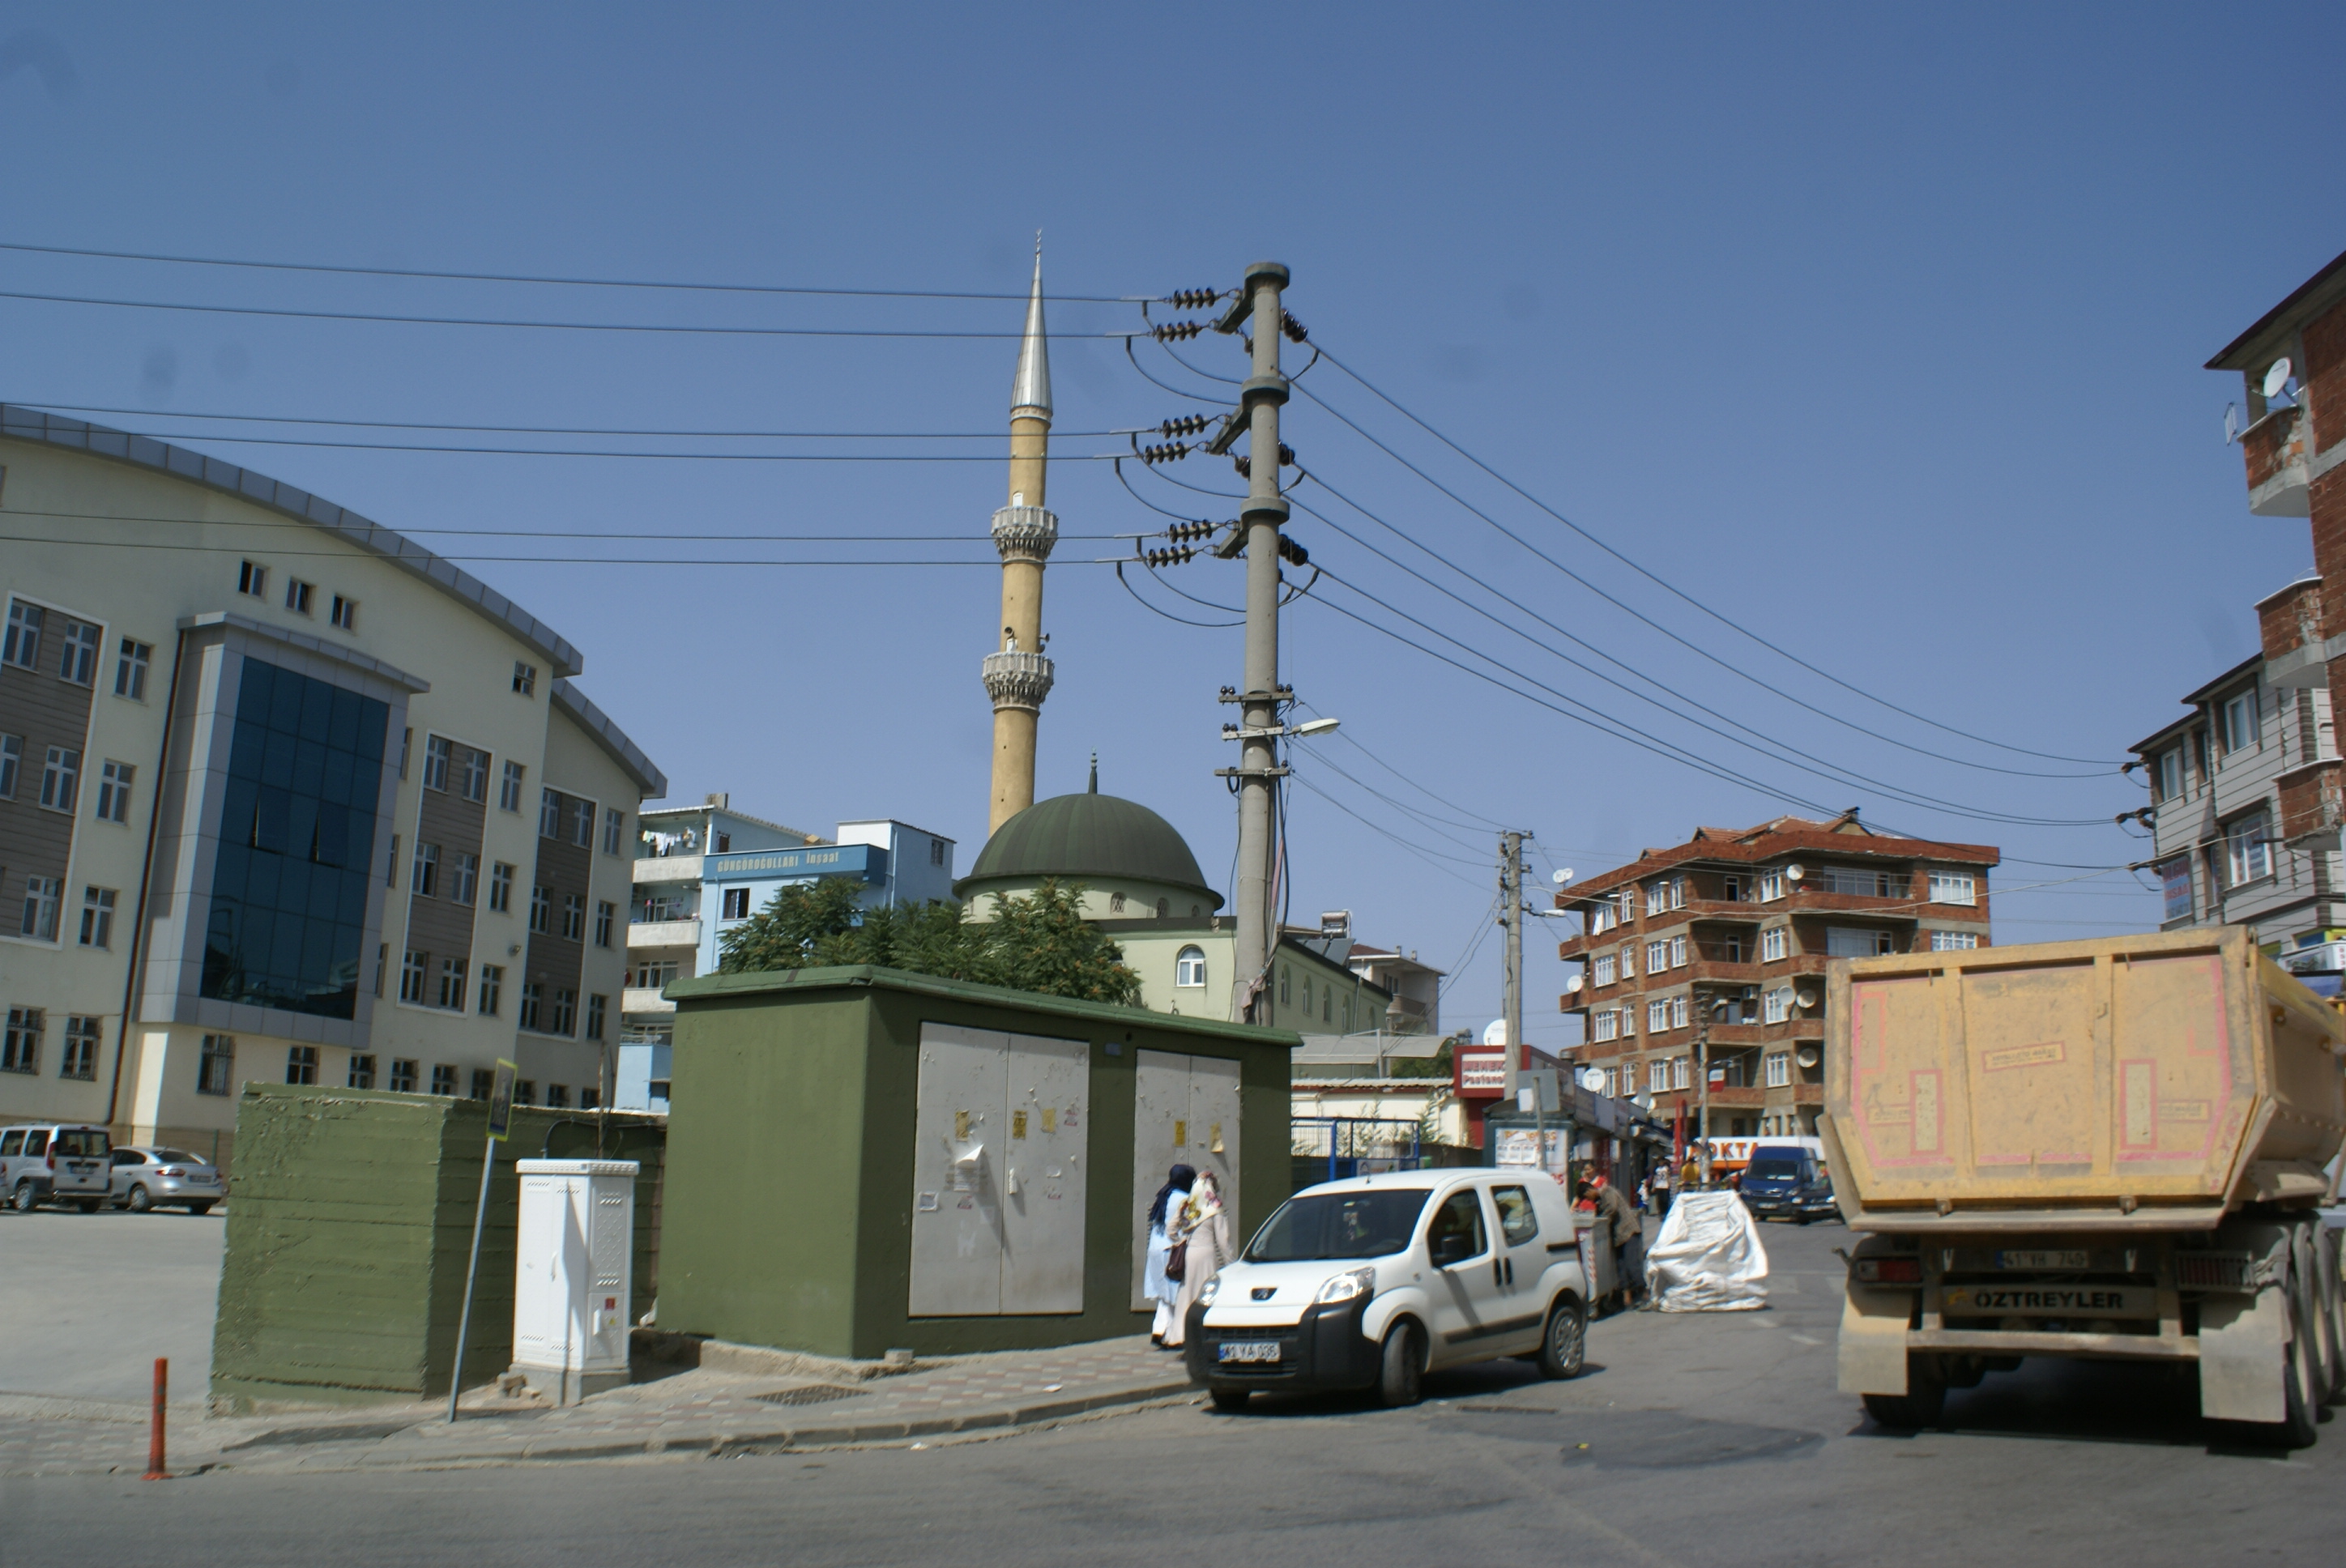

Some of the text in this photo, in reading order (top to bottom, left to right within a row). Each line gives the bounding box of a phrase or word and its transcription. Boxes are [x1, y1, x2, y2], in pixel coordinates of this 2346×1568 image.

[717, 851, 839, 873] GÜNGÖROĞULLARI İnşaat
[1463, 1060, 1506, 1072] MENEK
[1974, 1288, 2122, 1309] ÖZTREYLER
